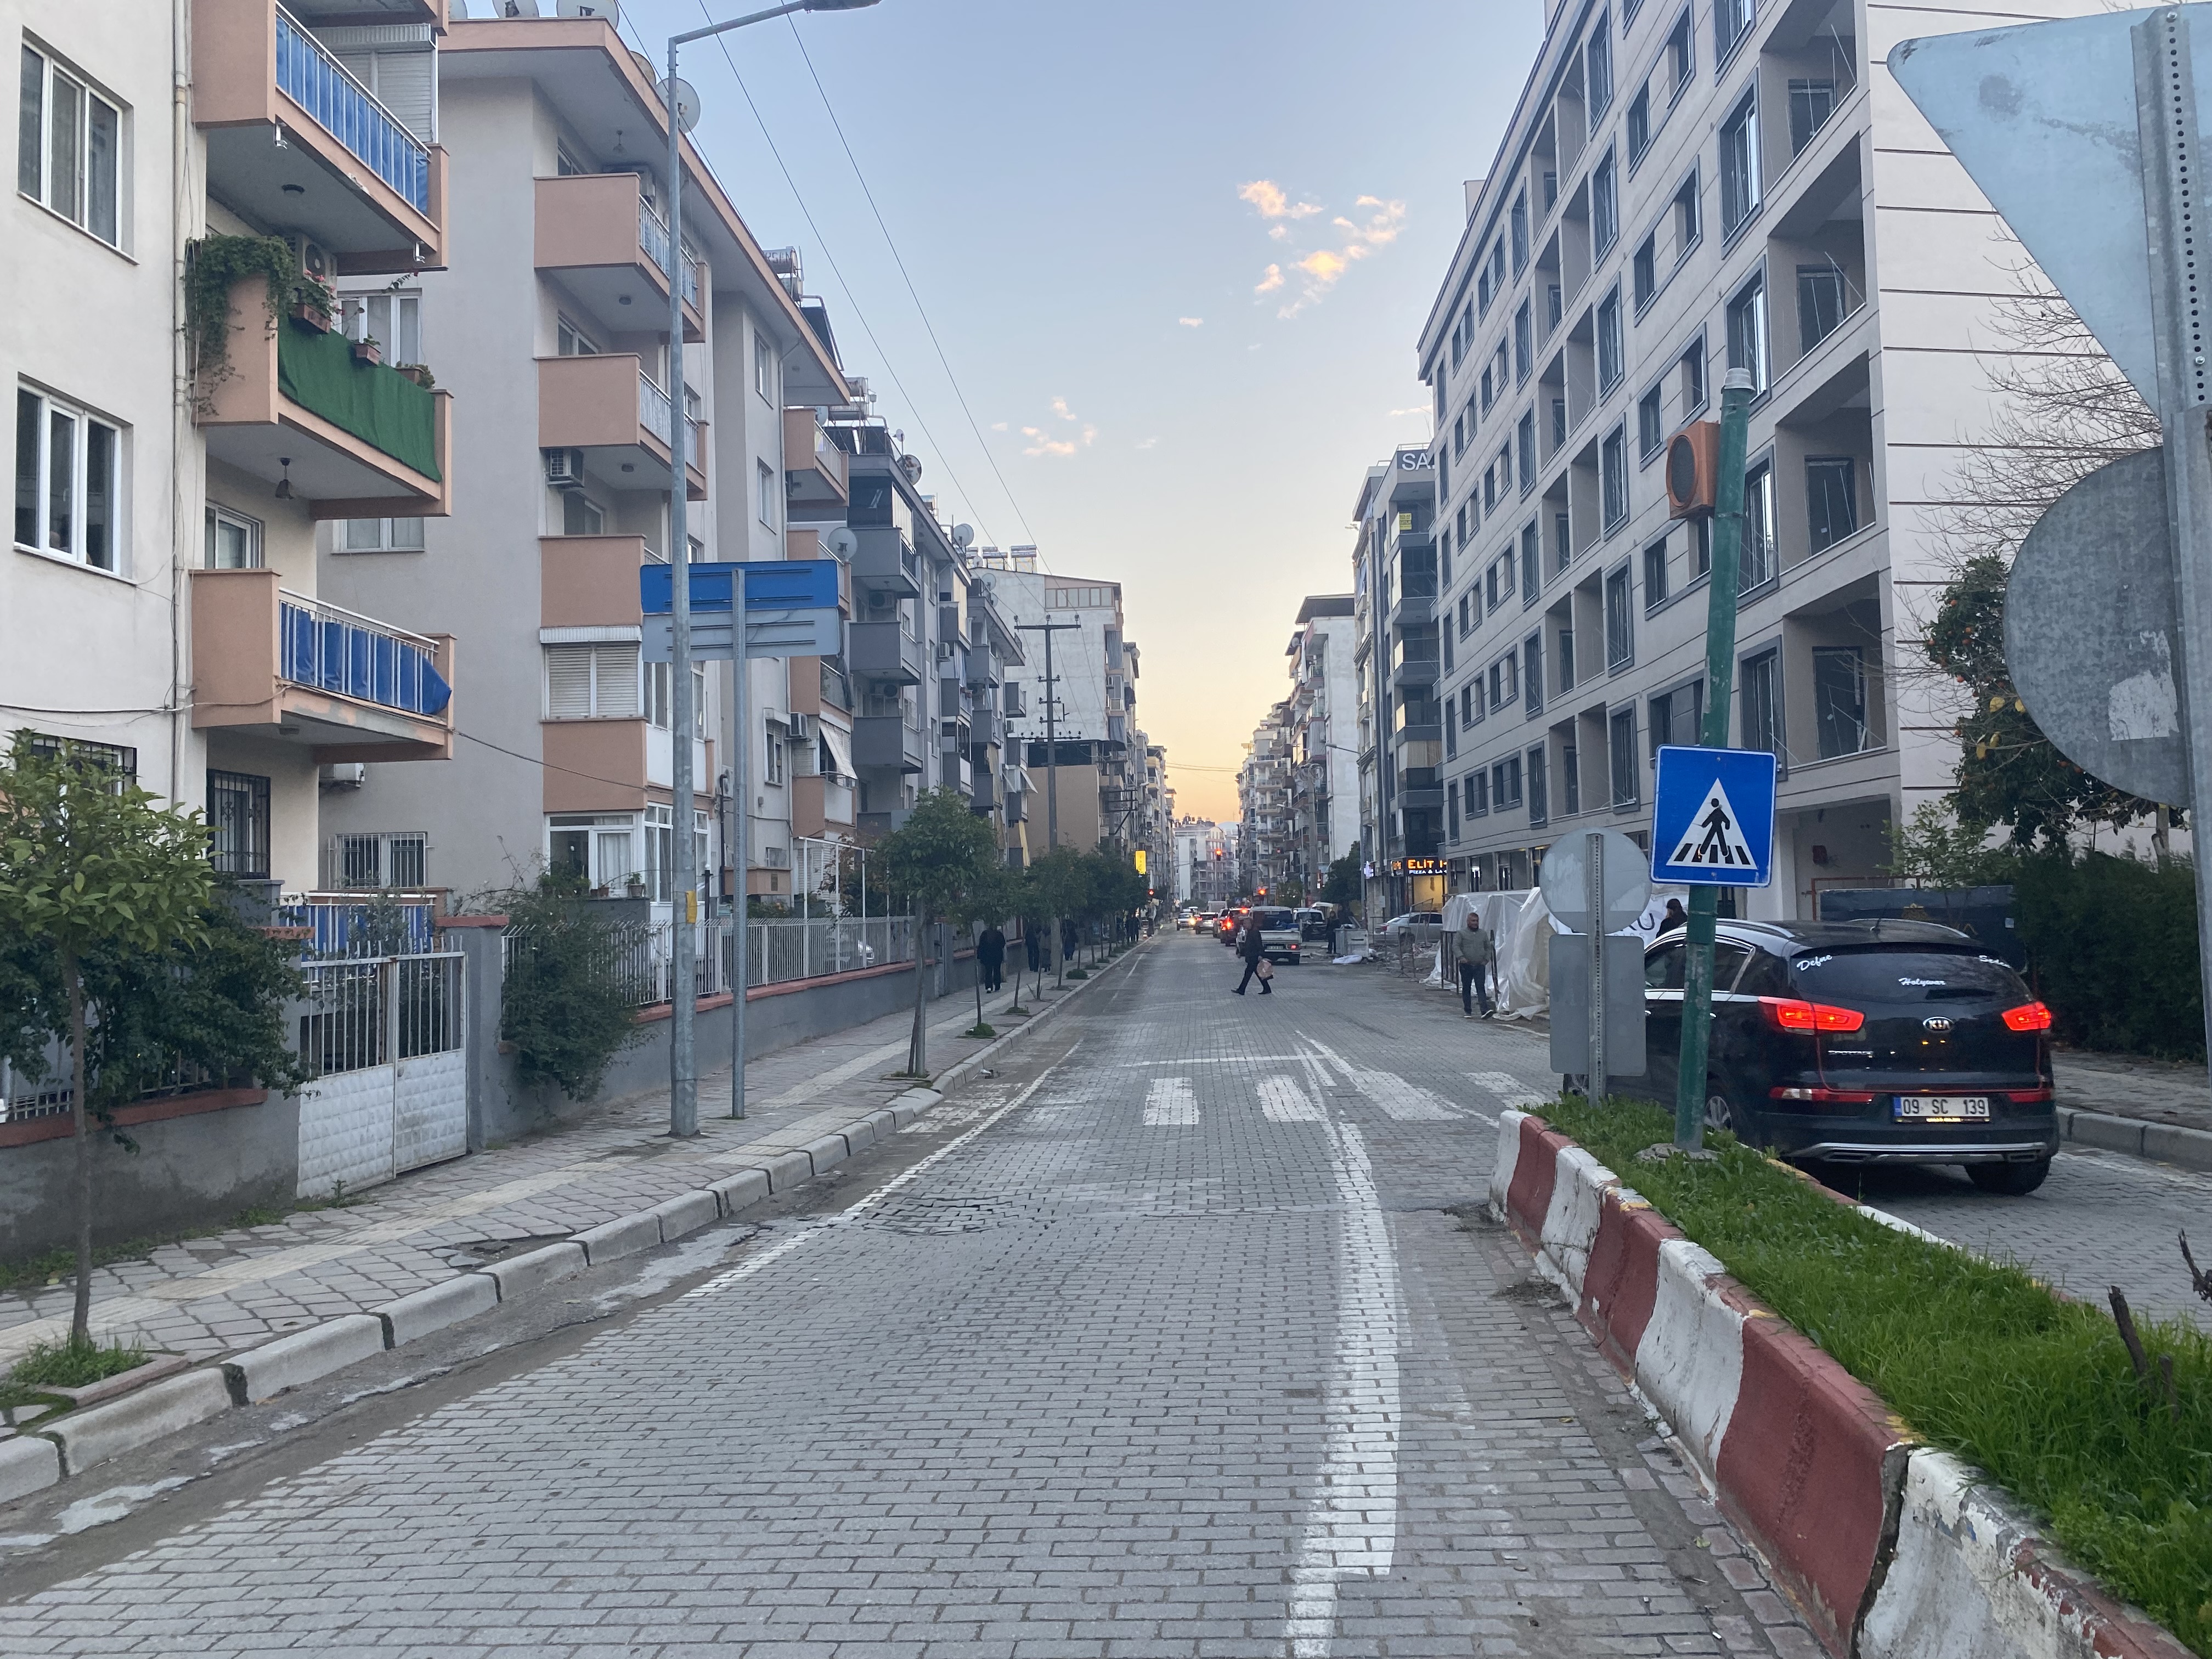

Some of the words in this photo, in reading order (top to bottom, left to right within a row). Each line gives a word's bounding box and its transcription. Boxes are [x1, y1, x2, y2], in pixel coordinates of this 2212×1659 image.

[1402, 452, 1435, 471] SA
[1903, 1098, 1920, 1114] 09
[1932, 1098, 1948, 1114] SC
[1963, 1099, 1985, 1115] 139
